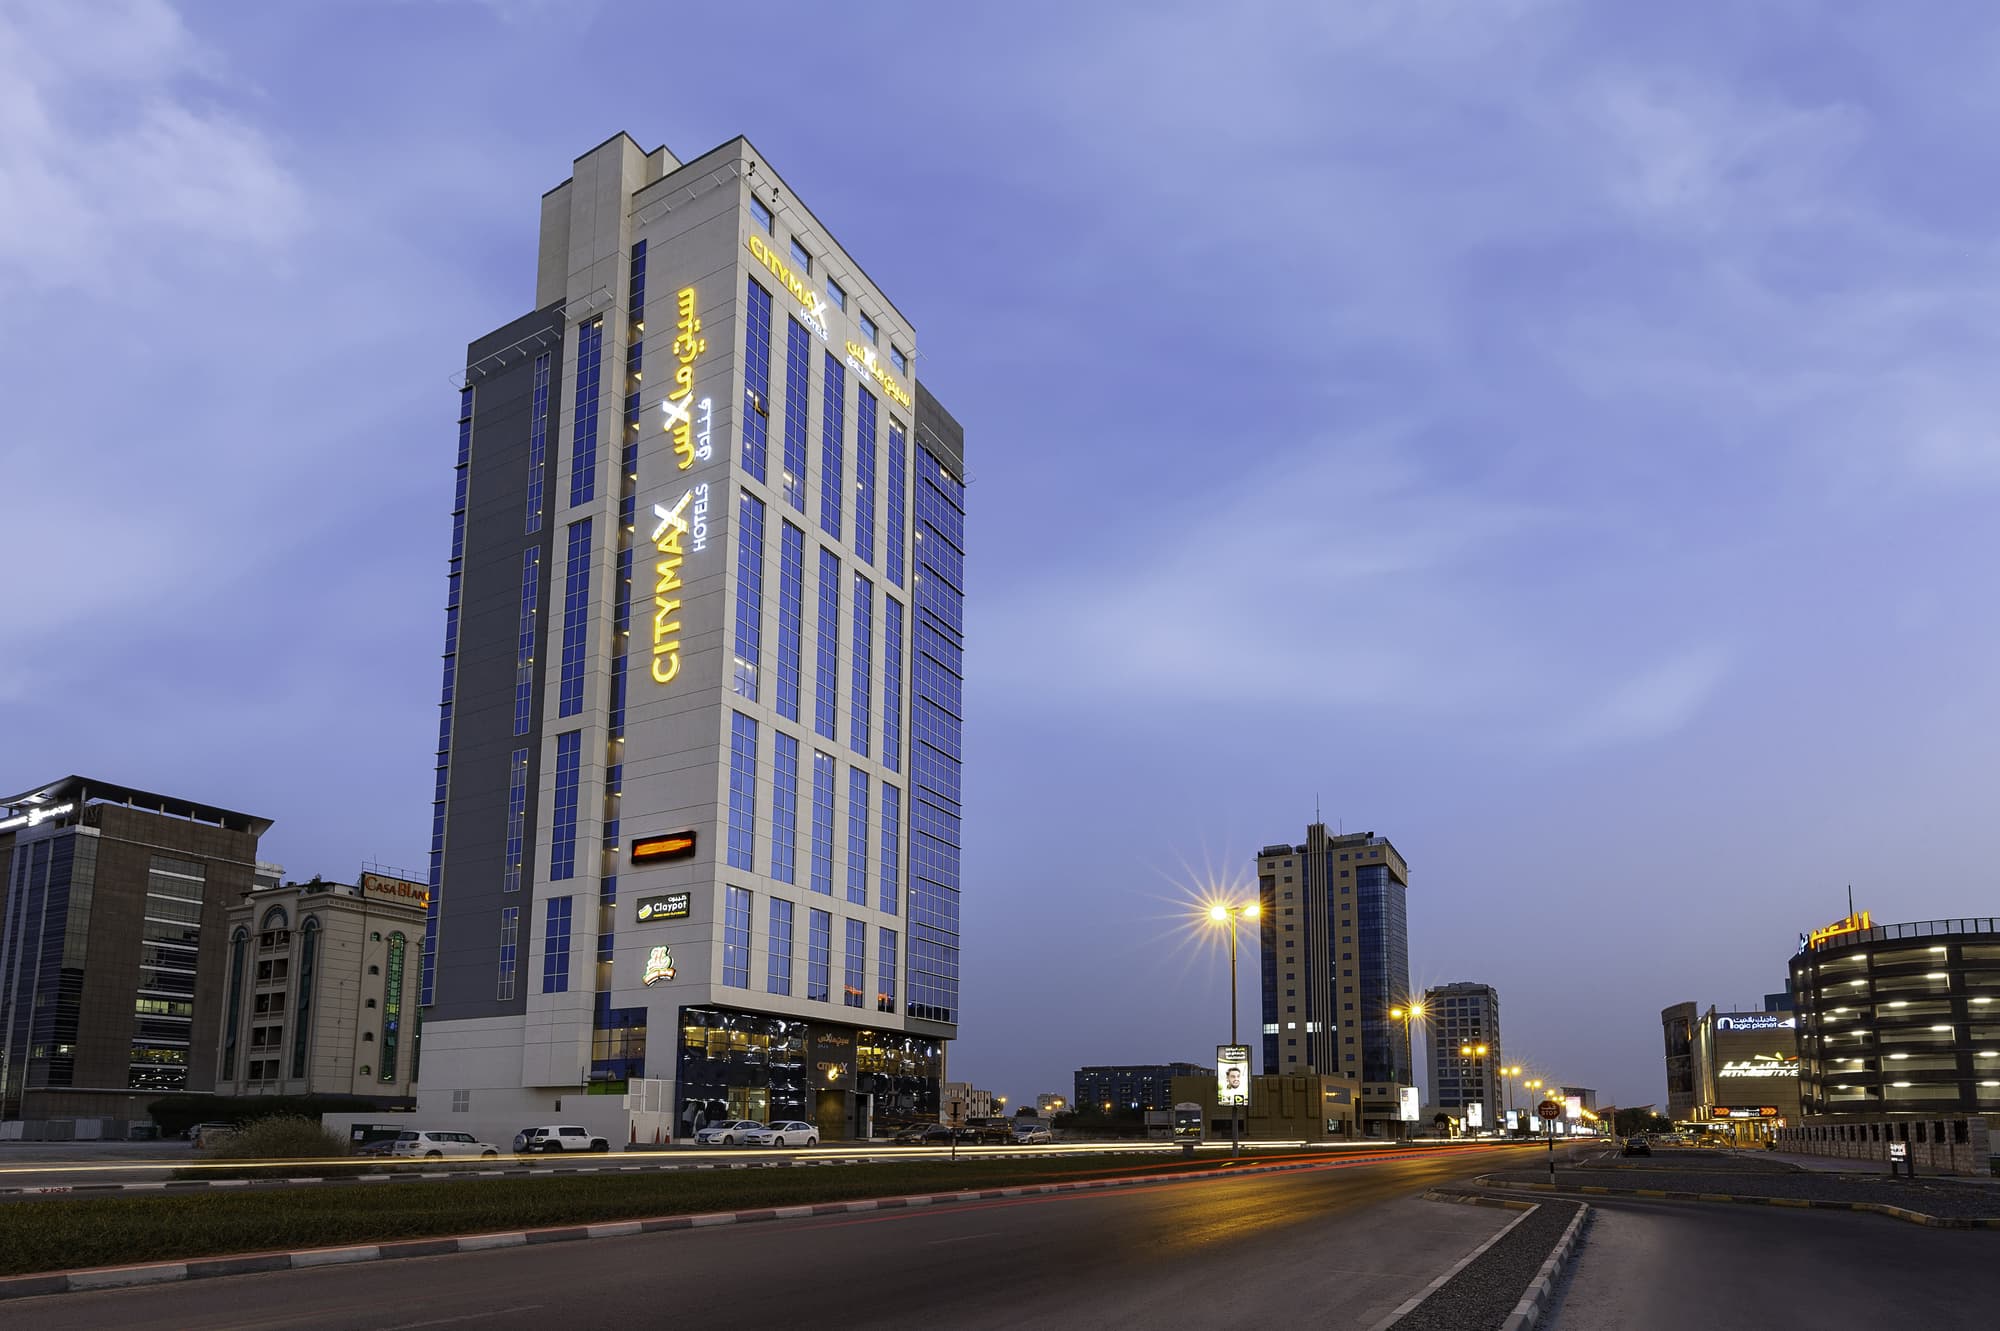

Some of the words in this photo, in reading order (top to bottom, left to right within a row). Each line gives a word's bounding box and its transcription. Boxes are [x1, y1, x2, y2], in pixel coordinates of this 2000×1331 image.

[749, 234, 828, 330] CITYMAX
[800, 307, 829, 341] HOTELS
[691, 482, 709, 552] HOTELS
[651, 489, 694, 684] CITYMAX
[653, 900, 687, 913] Claypot
[1810, 911, 1870, 950] النعيم
[1752, 1022, 1777, 1030] planet
